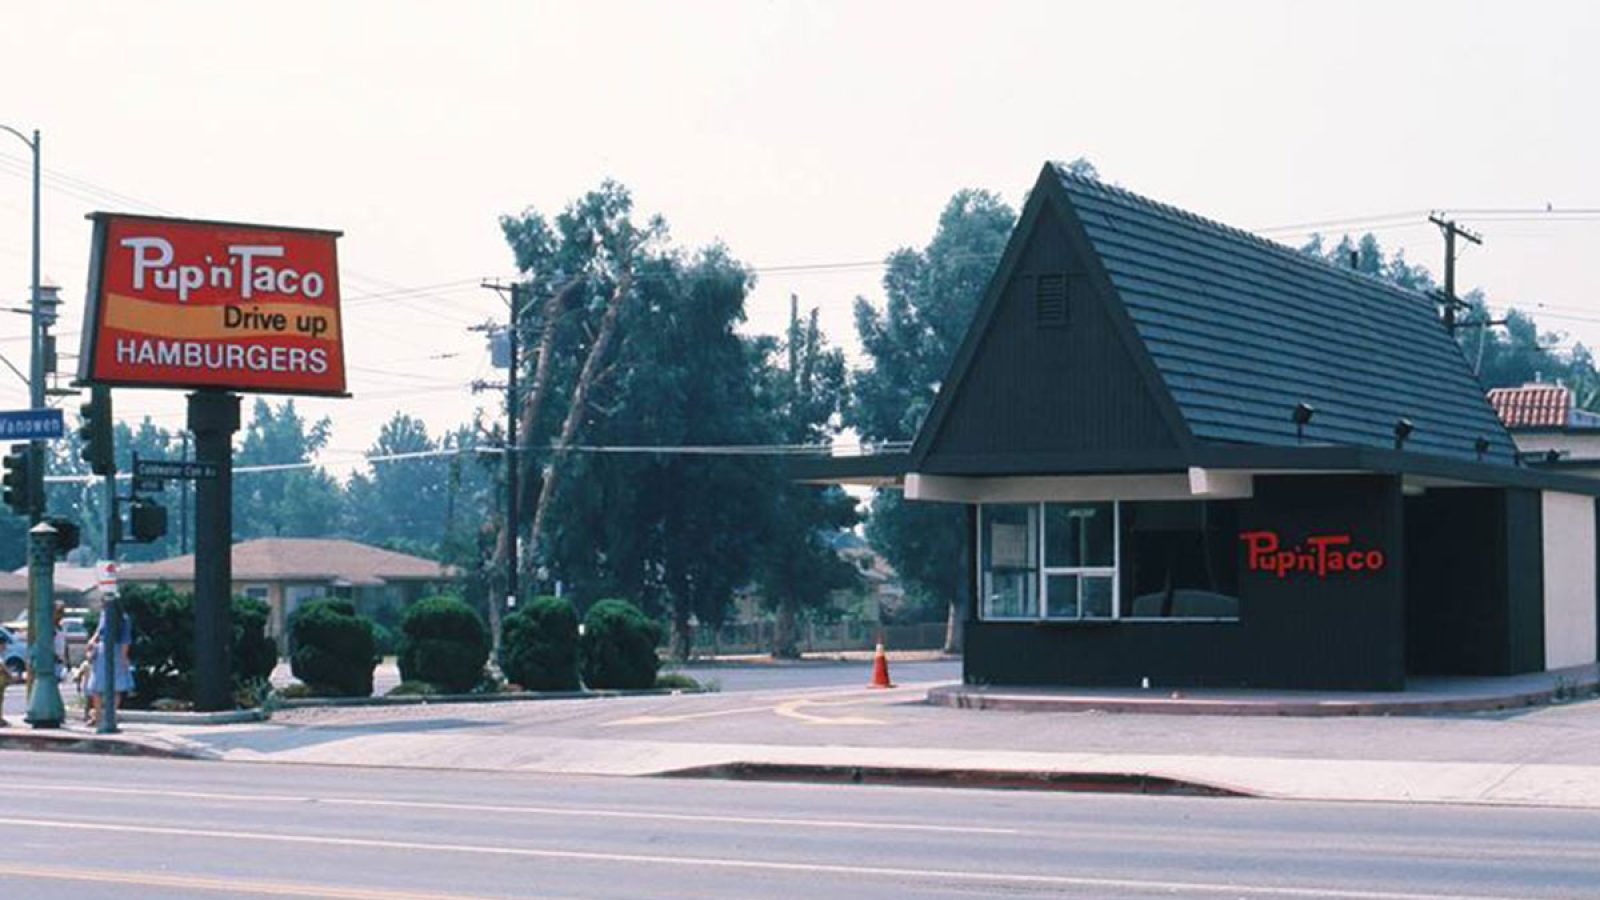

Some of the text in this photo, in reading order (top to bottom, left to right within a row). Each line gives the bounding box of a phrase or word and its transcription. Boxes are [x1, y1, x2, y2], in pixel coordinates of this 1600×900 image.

[223, 305, 328, 337] Drive up
[115, 339, 328, 373] HAMBURGERS
